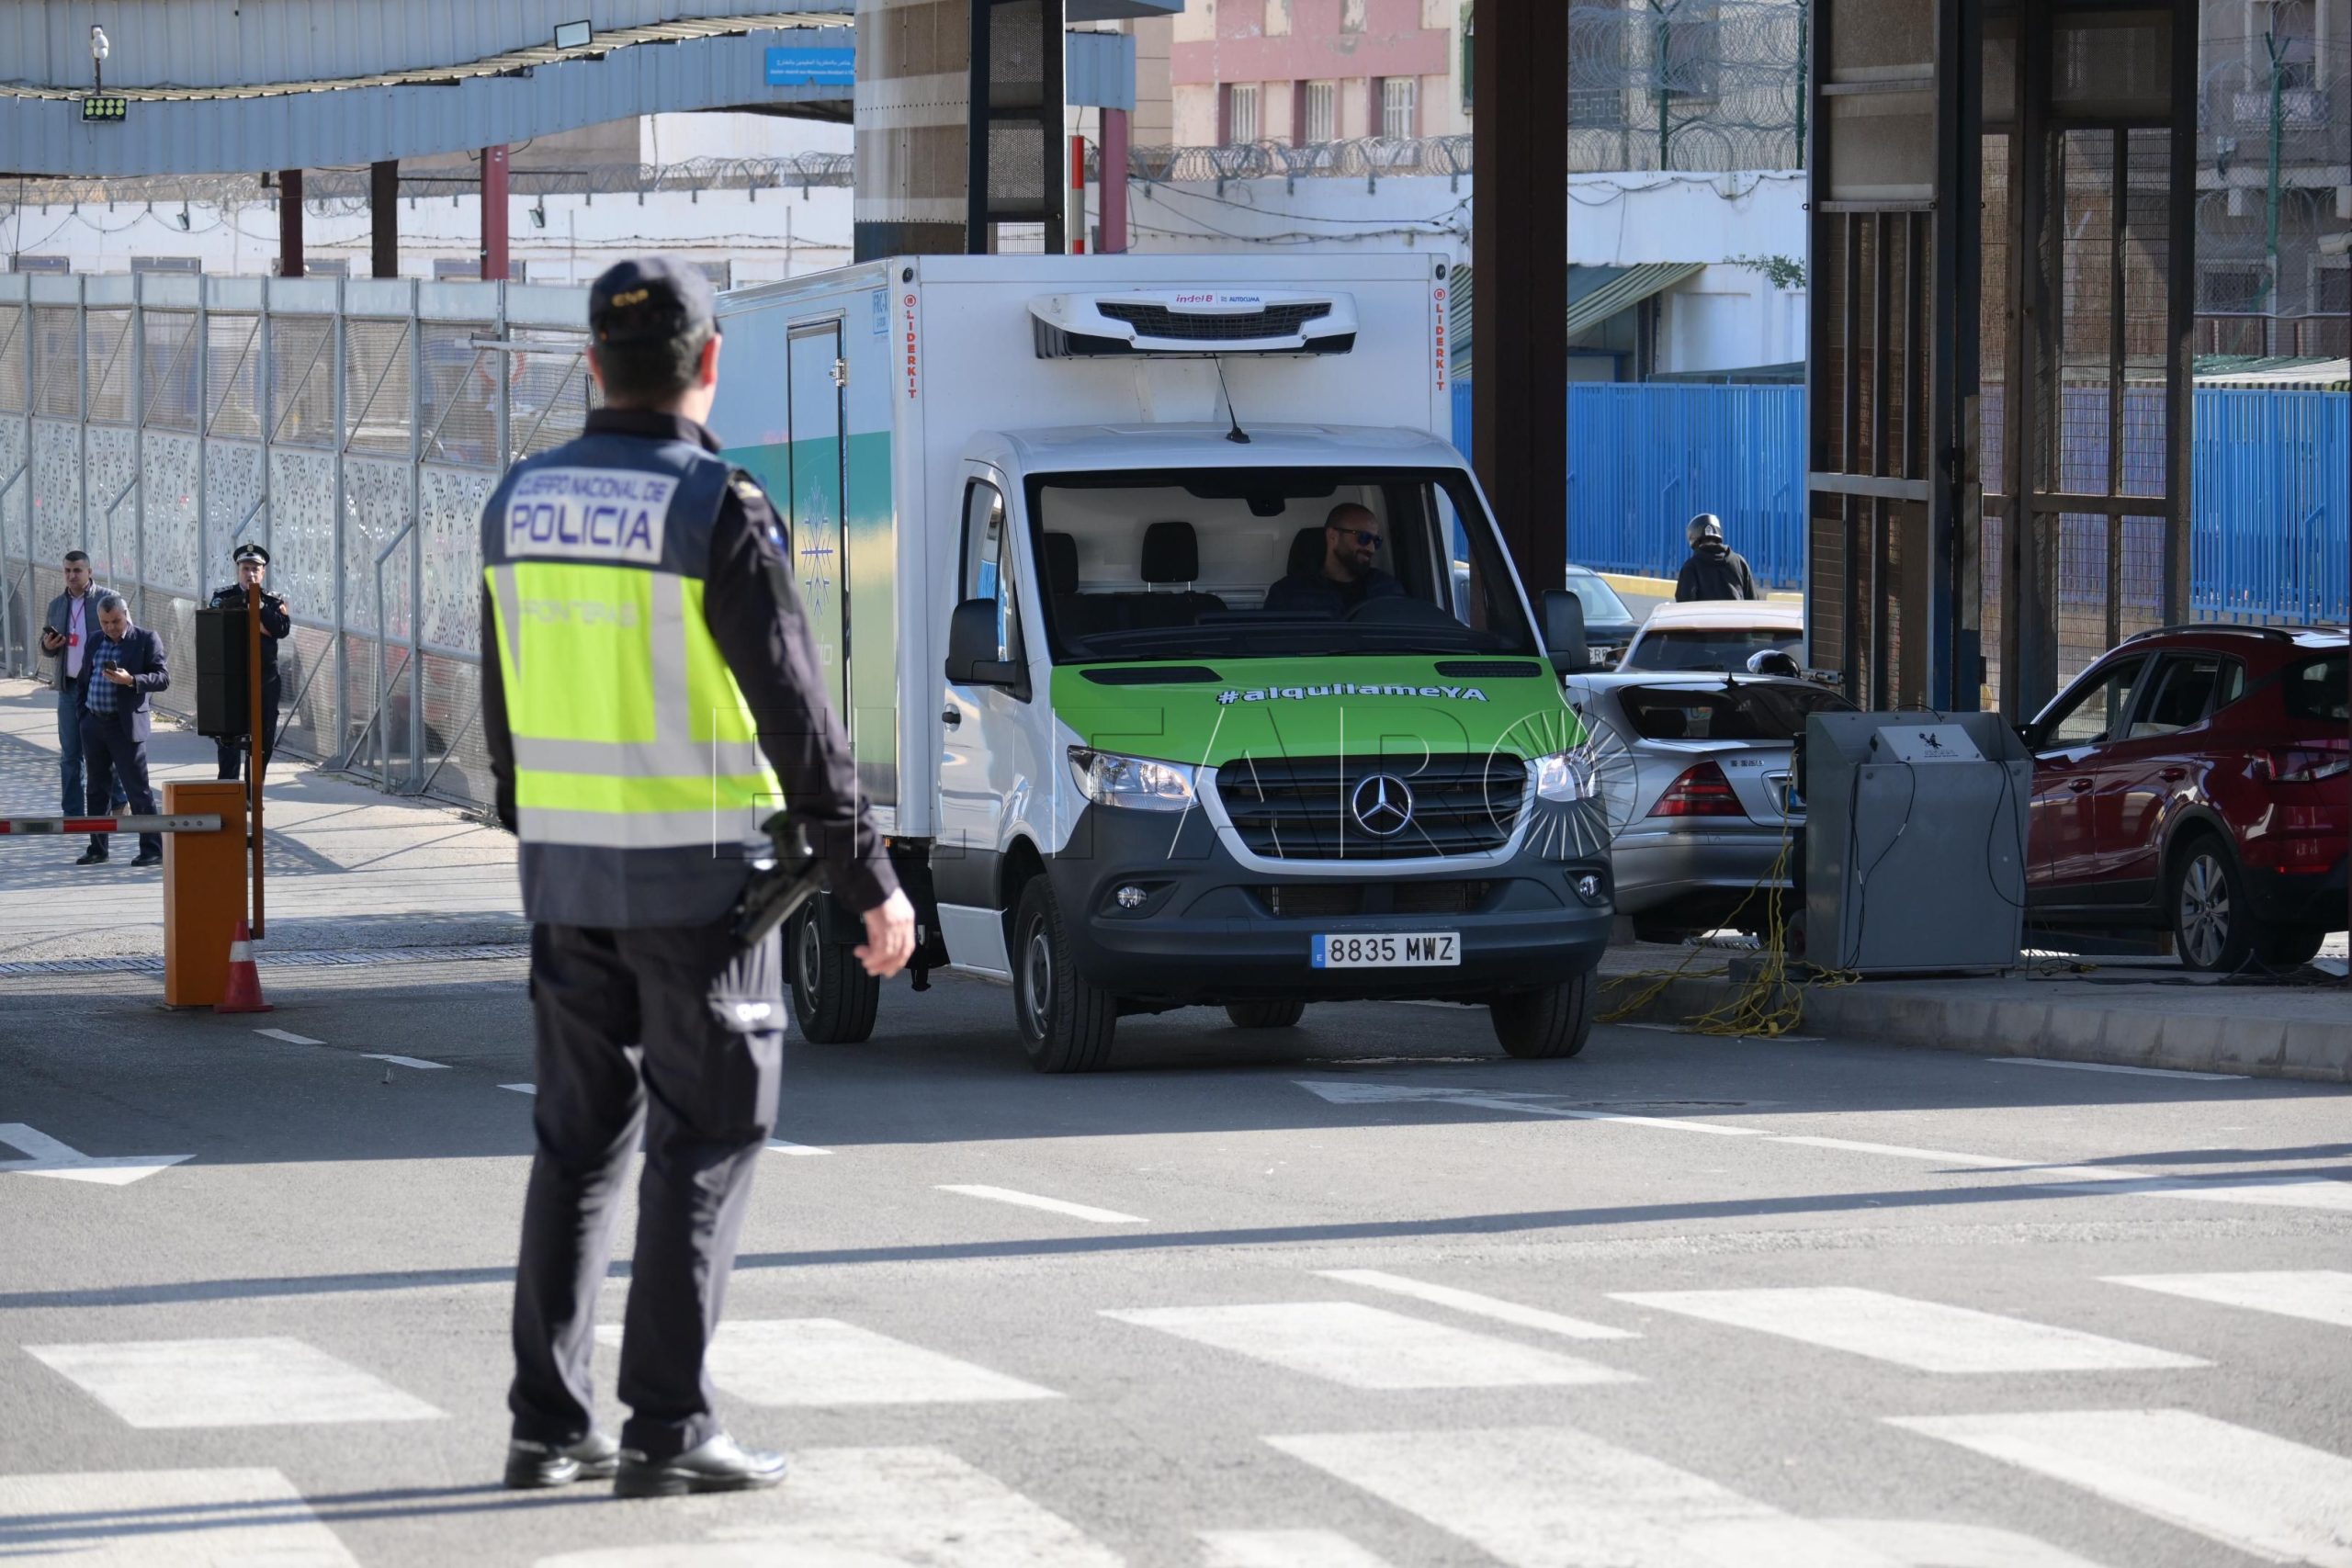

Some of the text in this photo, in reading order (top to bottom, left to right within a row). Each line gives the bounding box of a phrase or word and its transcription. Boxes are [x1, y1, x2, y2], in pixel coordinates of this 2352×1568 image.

[906, 310, 917, 399] LIDERKIT
[1435, 303, 1445, 391] LIDERKIT
[643, 480, 669, 502] DE
[510, 503, 652, 551] POLICIA
[1216, 682, 1490, 705] #alquilameYA
[1316, 936, 1453, 963] E 8835 MWZ
